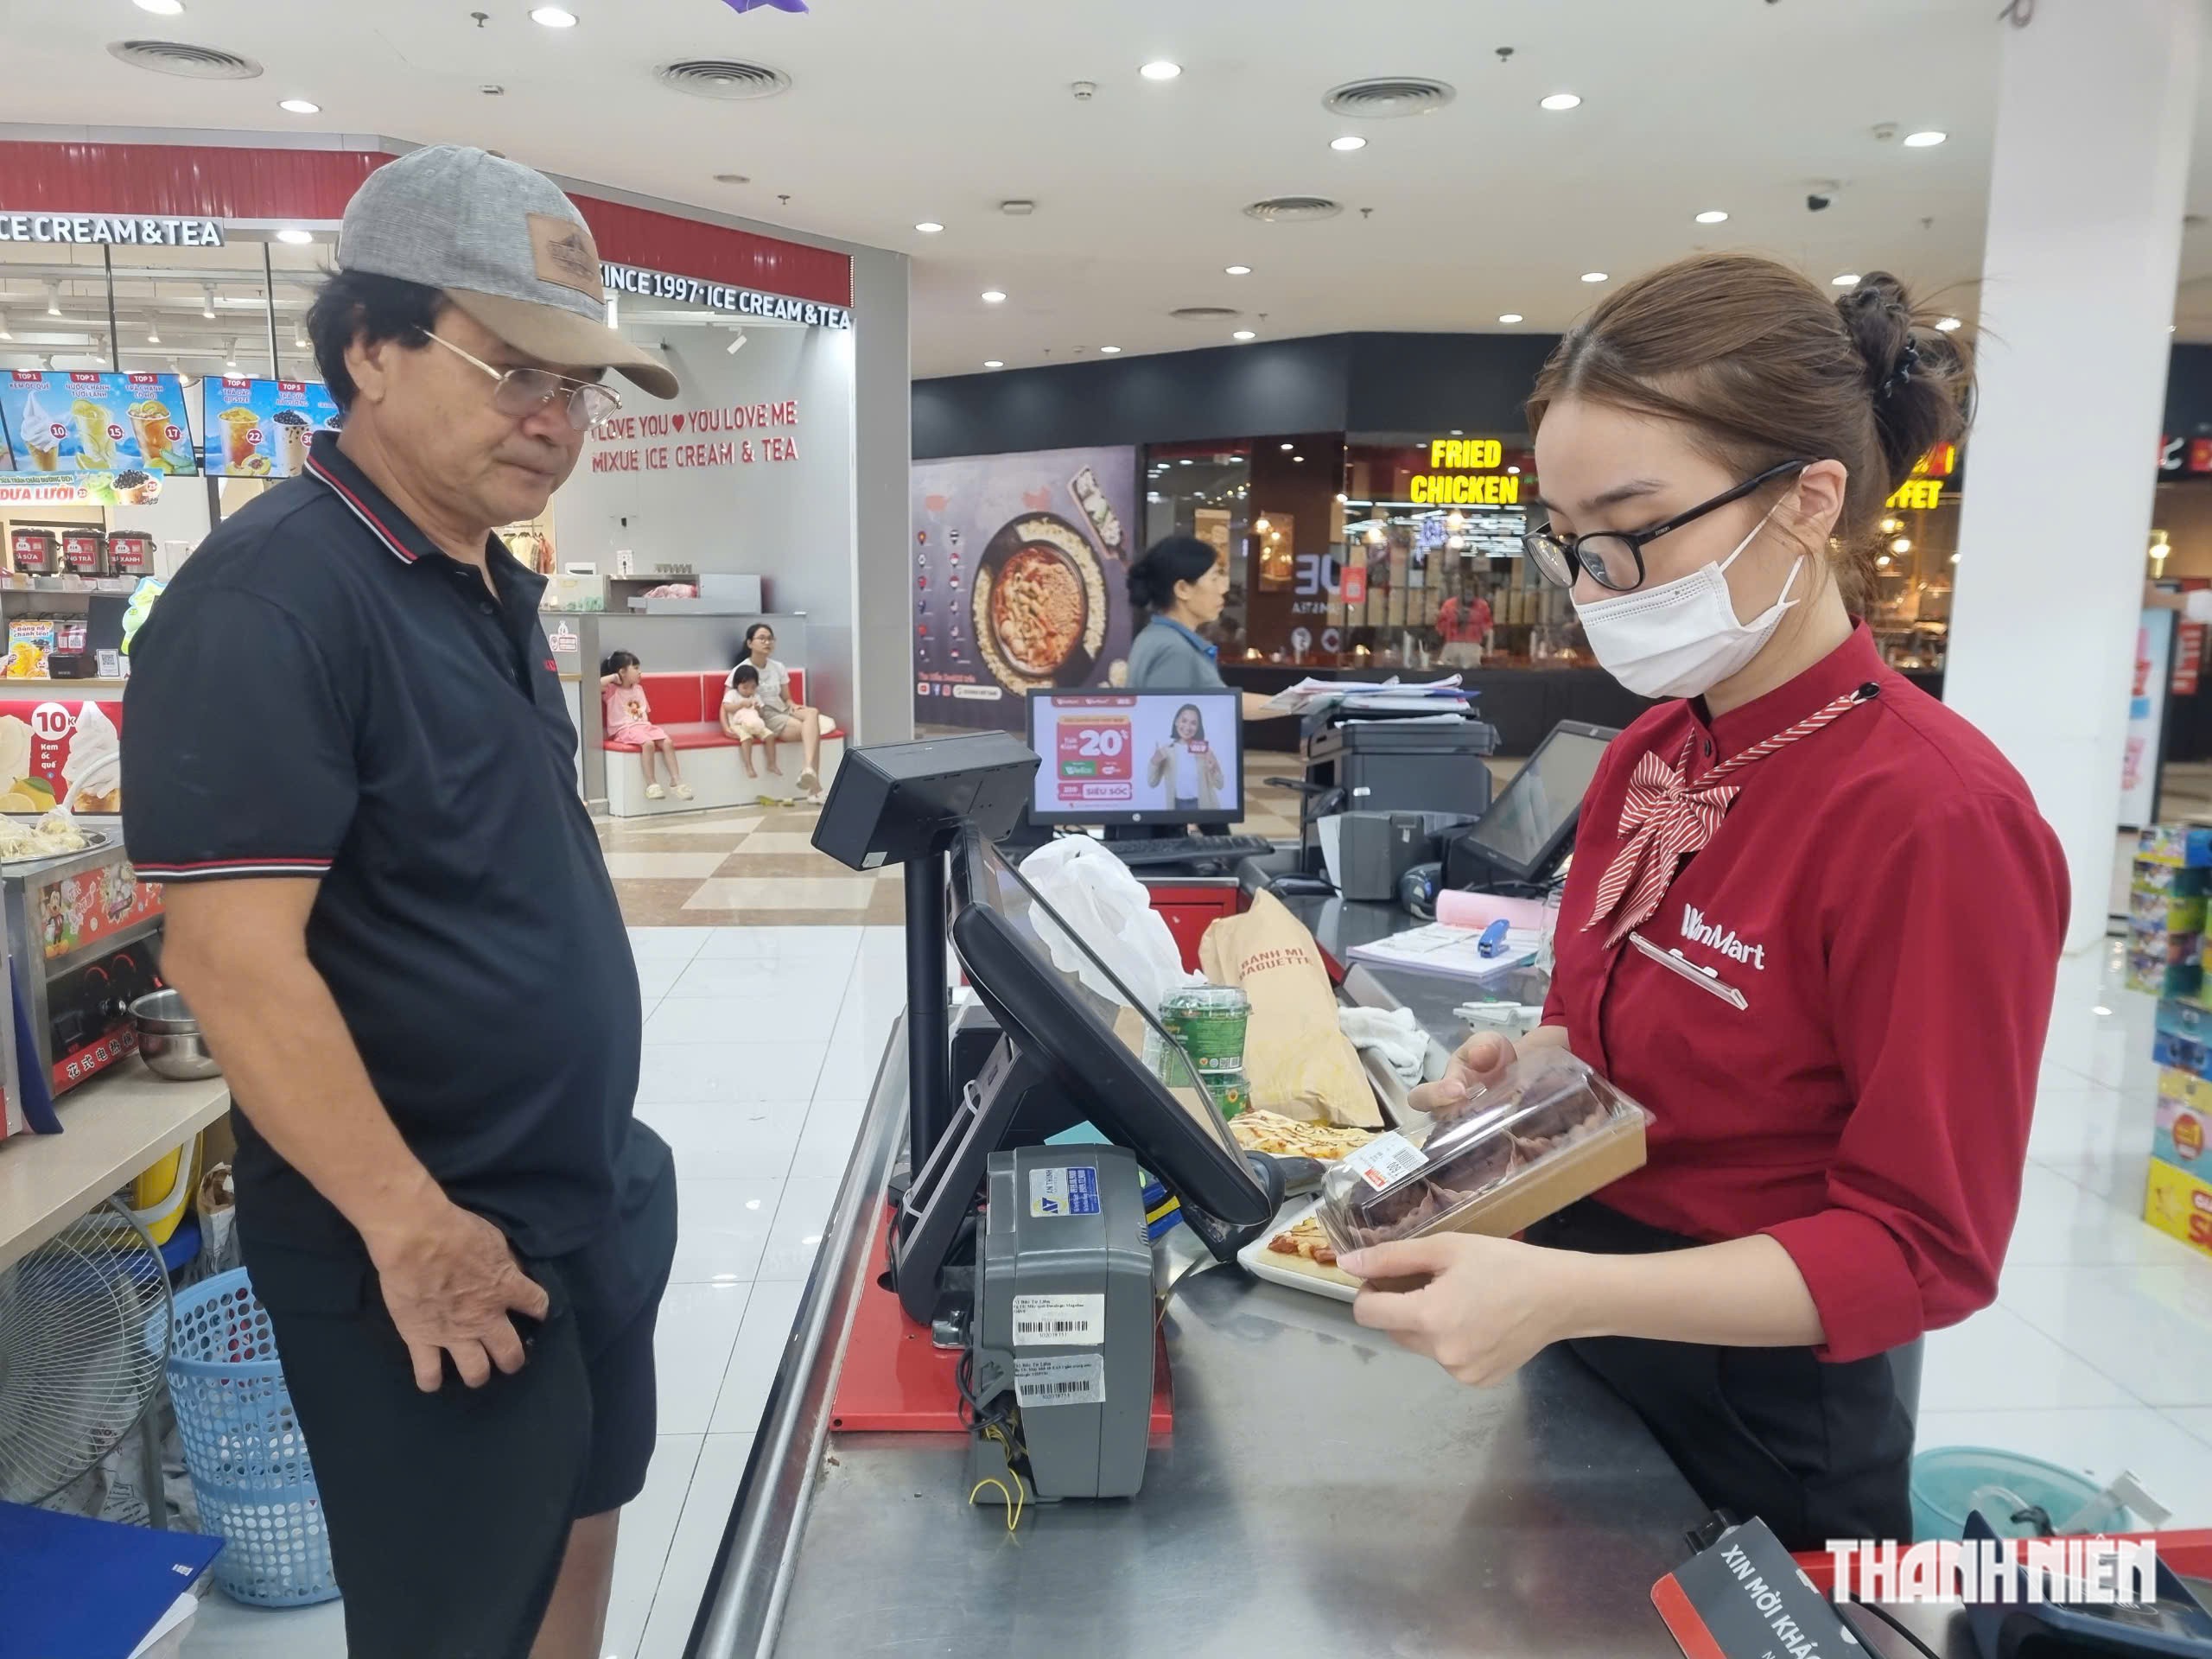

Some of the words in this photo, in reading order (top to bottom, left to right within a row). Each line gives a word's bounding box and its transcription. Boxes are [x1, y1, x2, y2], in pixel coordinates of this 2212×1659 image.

[35, 216, 137, 244] CREAM
[600, 264, 650, 295] INCE
[706, 285, 736, 310] ICE
[740, 292, 802, 321] CREAM
[52, 427, 64, 436] 10
[110, 428, 122, 437] 15
[168, 429, 179, 438] 17
[598, 416, 635, 442] LOVE
[639, 413, 669, 436] YOU
[690, 408, 720, 432] YOU
[725, 404, 768, 430] LOVE
[772, 400, 798, 426] ME
[248, 432, 260, 442] 22
[592, 449, 639, 473] MIXUE
[645, 447, 669, 471] ICE
[676, 442, 735, 467] CREAM
[741, 440, 756, 464] &
[762, 435, 798, 461] TEA
[1430, 439, 1502, 468] FRIED
[1410, 474, 1519, 505] CHICKEN
[1681, 903, 1765, 970] WinMart
[1720, 1543, 1757, 1581] XIN
[1744, 1576, 1783, 1618] MỜI
